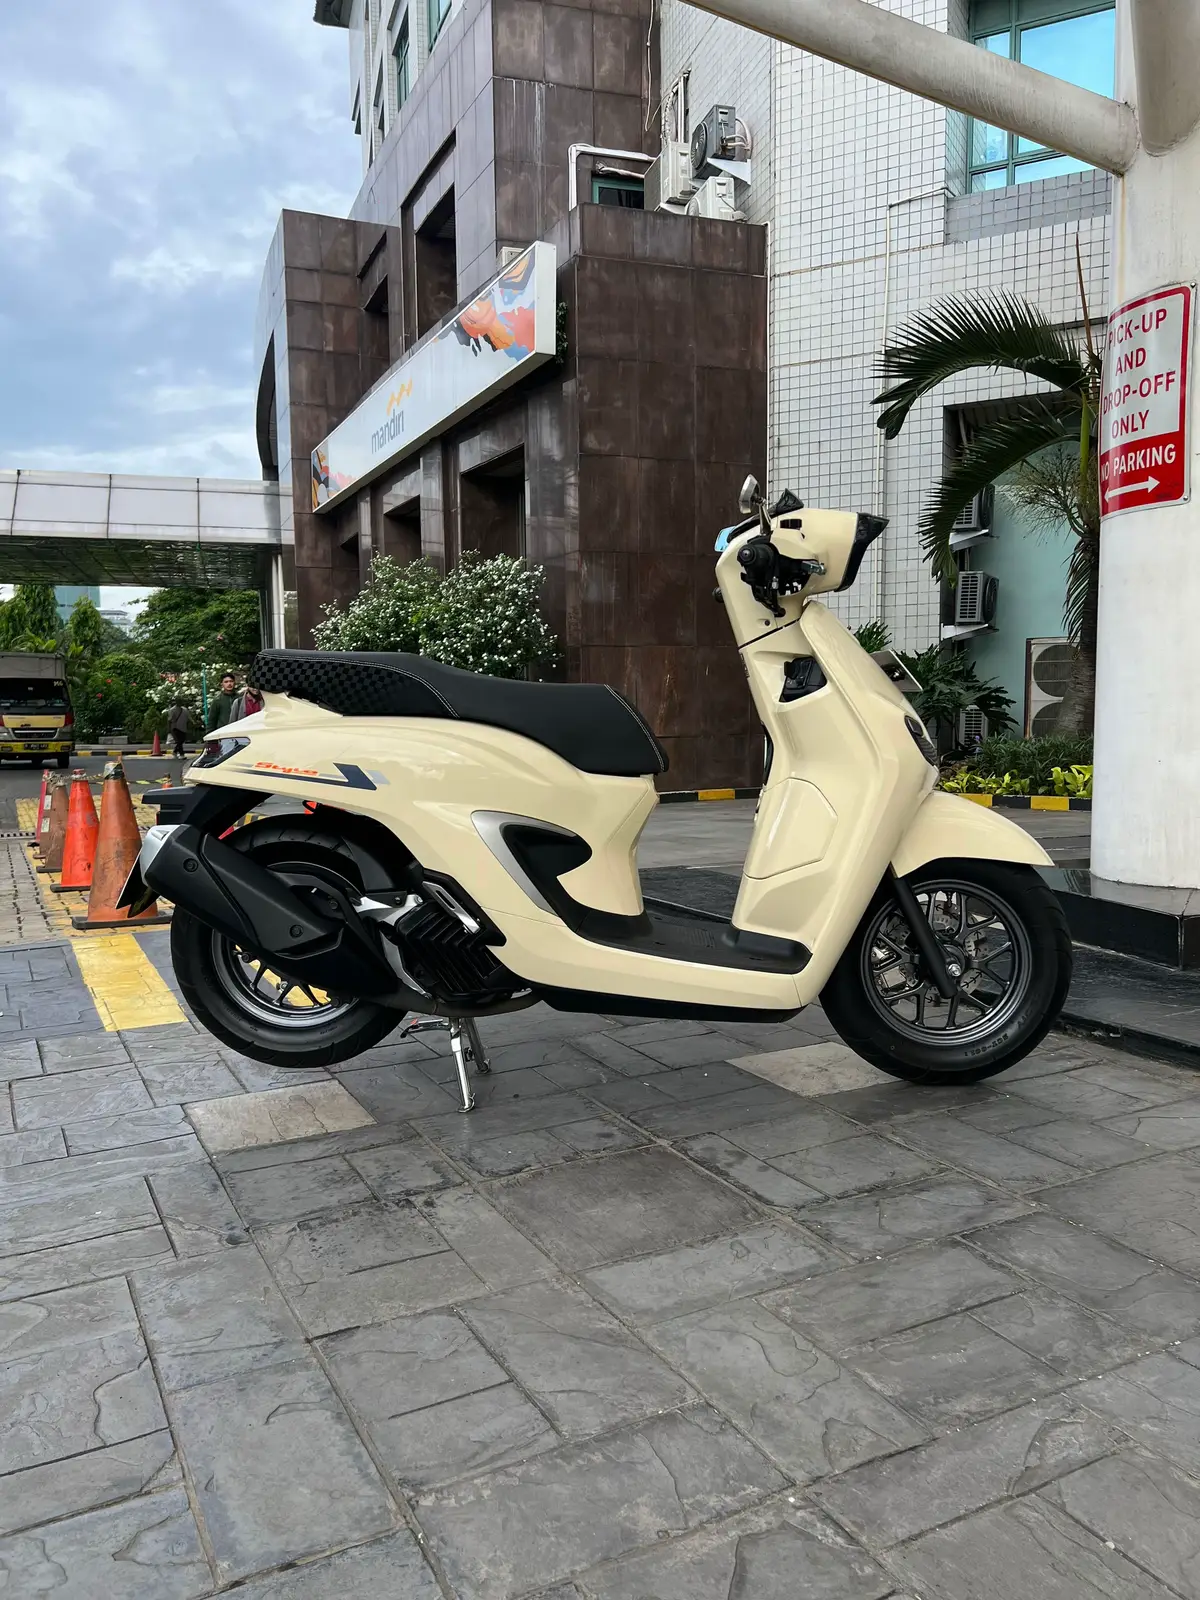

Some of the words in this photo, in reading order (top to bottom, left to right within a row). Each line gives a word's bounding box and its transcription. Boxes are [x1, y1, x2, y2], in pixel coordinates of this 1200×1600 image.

[1108, 308, 1167, 350] PICK-UP
[1115, 347, 1147, 376] AND
[1103, 370, 1176, 414] DROP-OFF
[371, 409, 404, 454] mandiri
[1111, 409, 1150, 439] ONLY
[1113, 443, 1176, 477] PARKING
